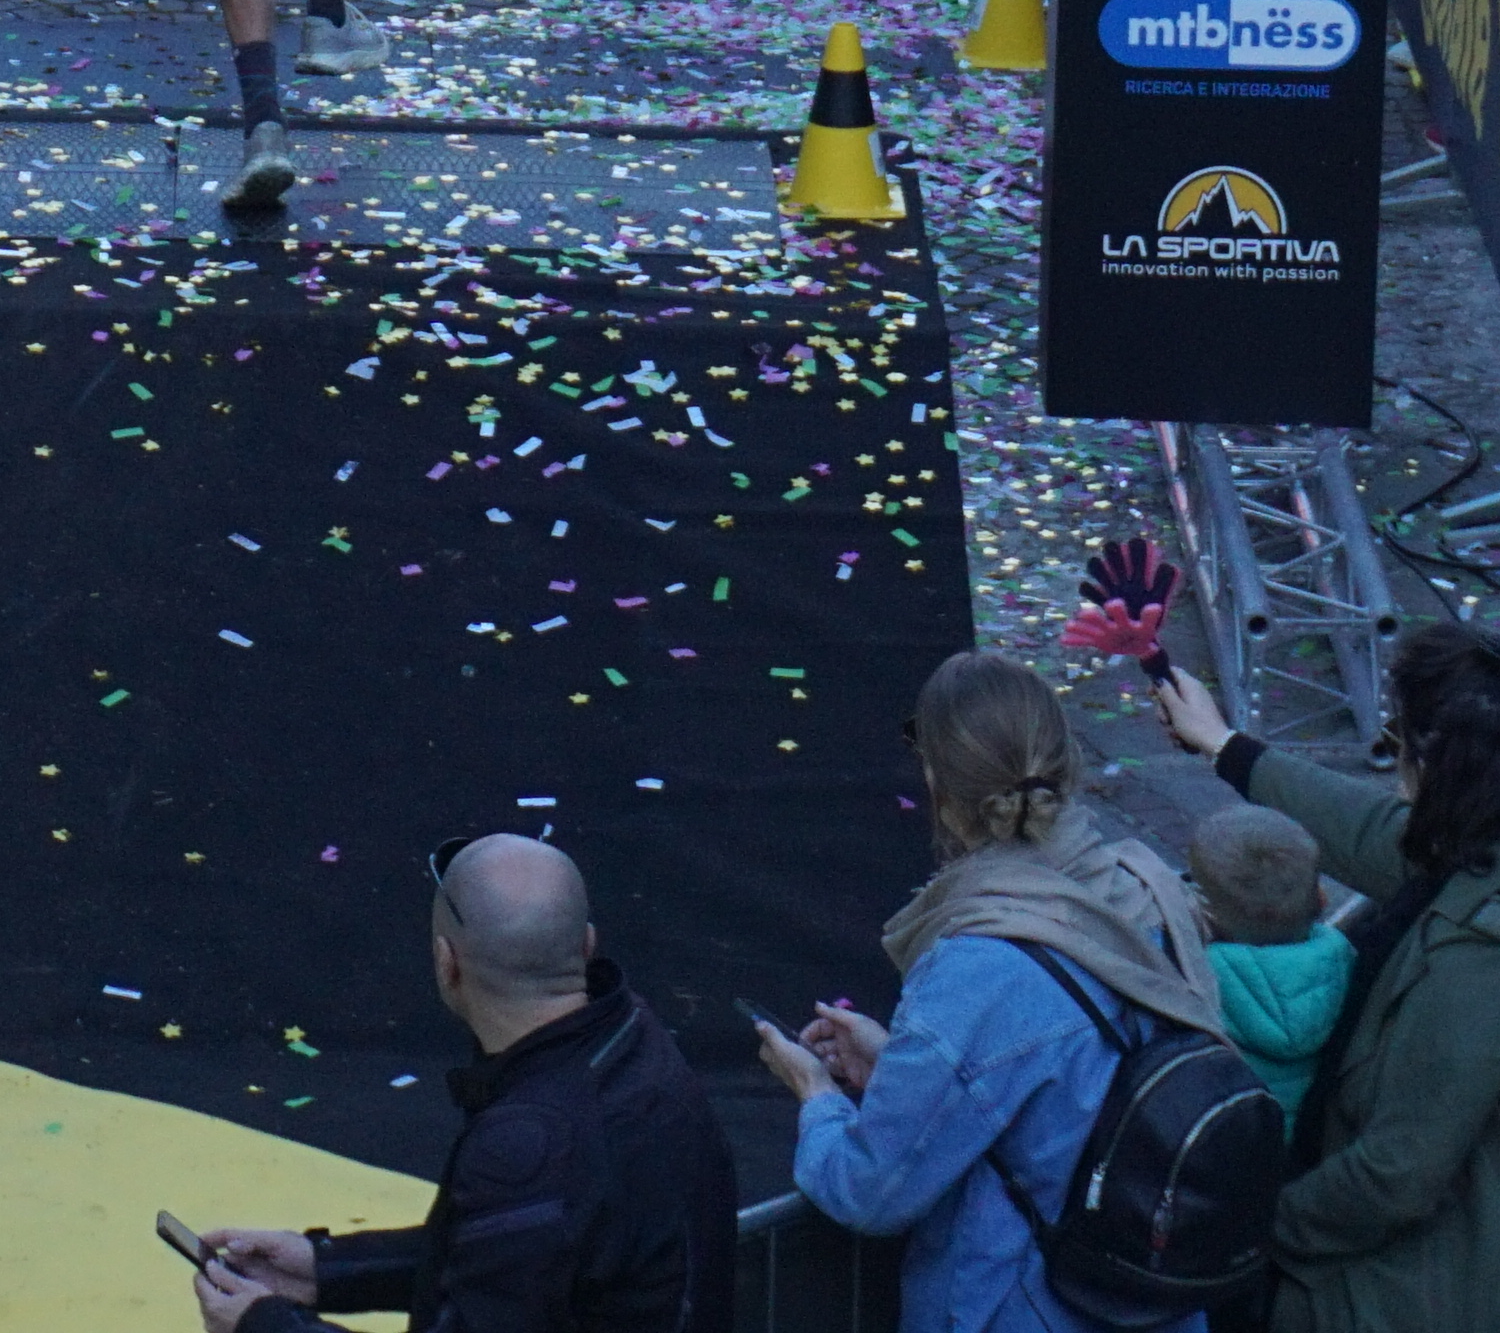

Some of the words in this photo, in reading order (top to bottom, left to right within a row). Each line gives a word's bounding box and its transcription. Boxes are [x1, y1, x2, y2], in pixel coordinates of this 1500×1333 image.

[1128, 2, 1344, 51] mtbnëss
[1126, 80, 1193, 94] RICERCA
[1198, 81, 1208, 96] E
[1213, 83, 1329, 98] INTEGRAZIONE
[1103, 235, 1146, 256] LA
[1157, 237, 1340, 263] SPORTIVA
[1103, 257, 1208, 276] innovation
[1215, 264, 1256, 277] with
[1263, 261, 1338, 281] passion
